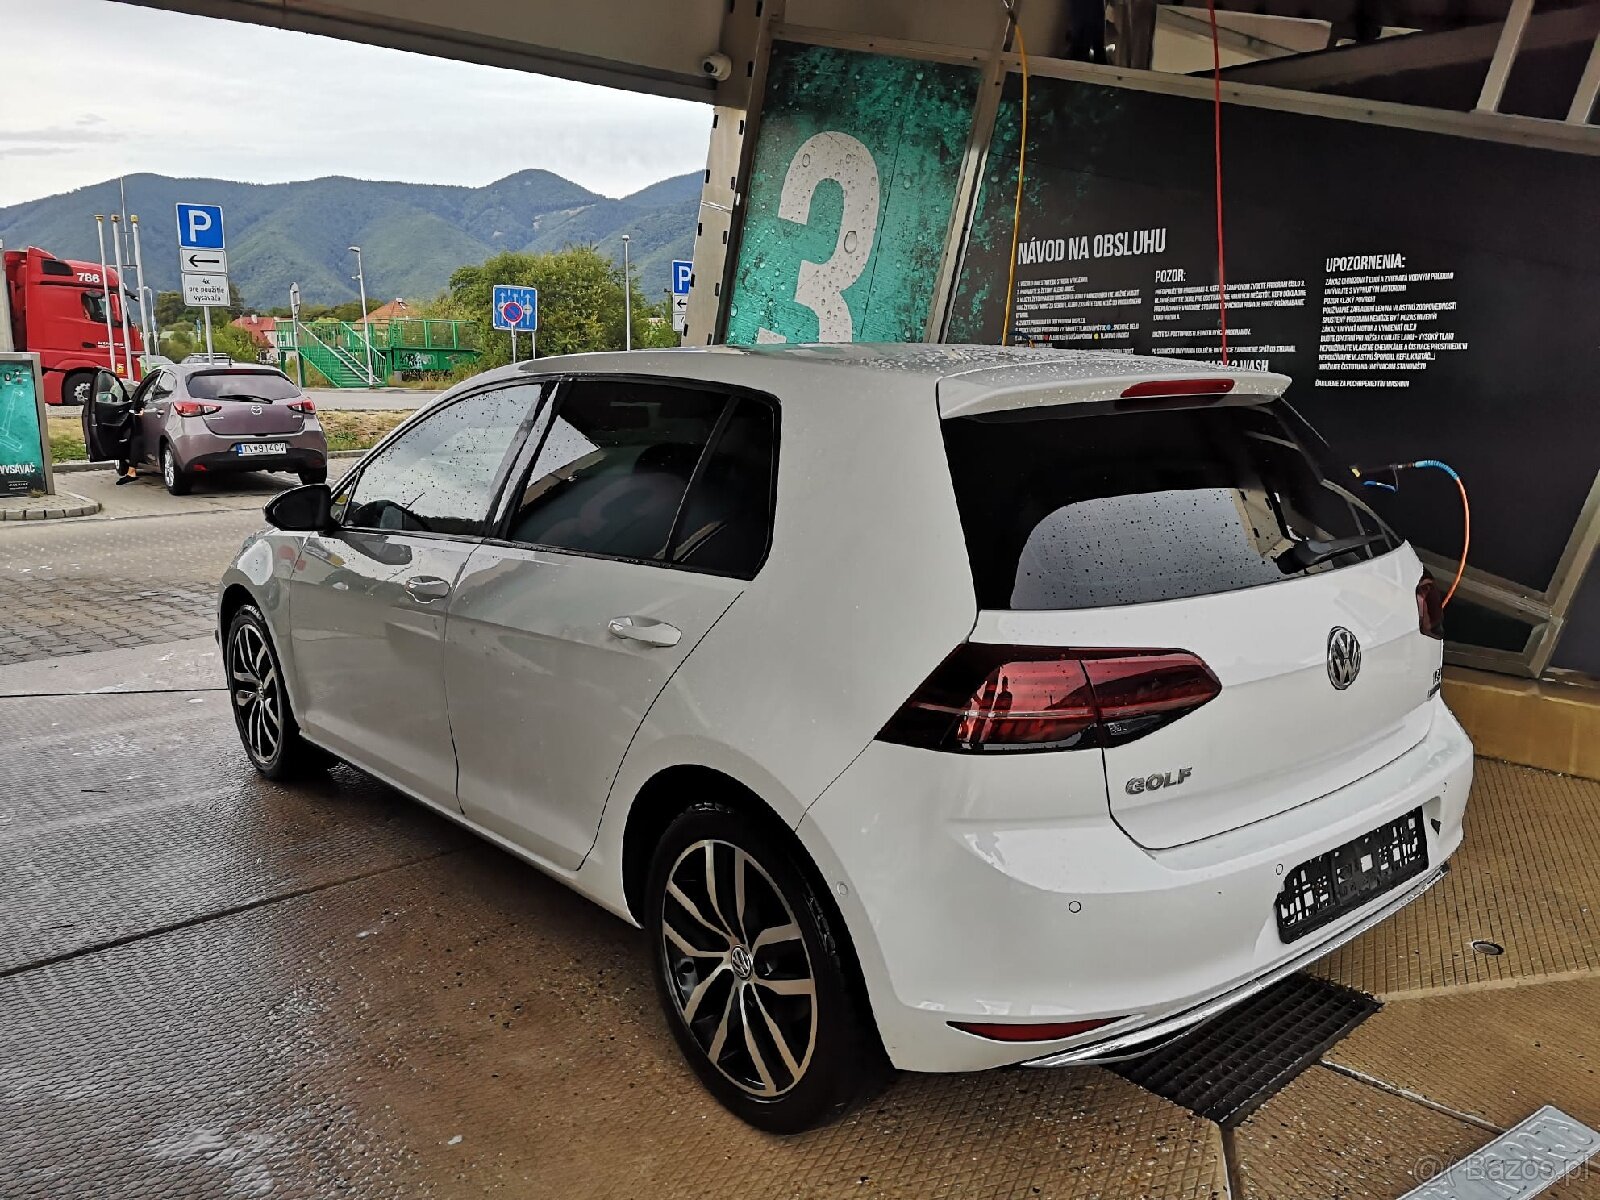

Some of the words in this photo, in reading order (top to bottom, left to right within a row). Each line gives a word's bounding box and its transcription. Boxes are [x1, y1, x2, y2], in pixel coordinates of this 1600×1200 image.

[188, 209, 212, 242] P
[1017, 237, 1065, 265] NÁVOD
[1068, 236, 1089, 260] NA
[1093, 228, 1167, 258] OBSLUHU
[1155, 269, 1187, 283] POZOR:
[1326, 254, 1407, 273] UPOZORNENIA:
[76, 272, 100, 283] 786
[678, 266, 691, 291] P
[1125, 767, 1193, 794] GOLF
